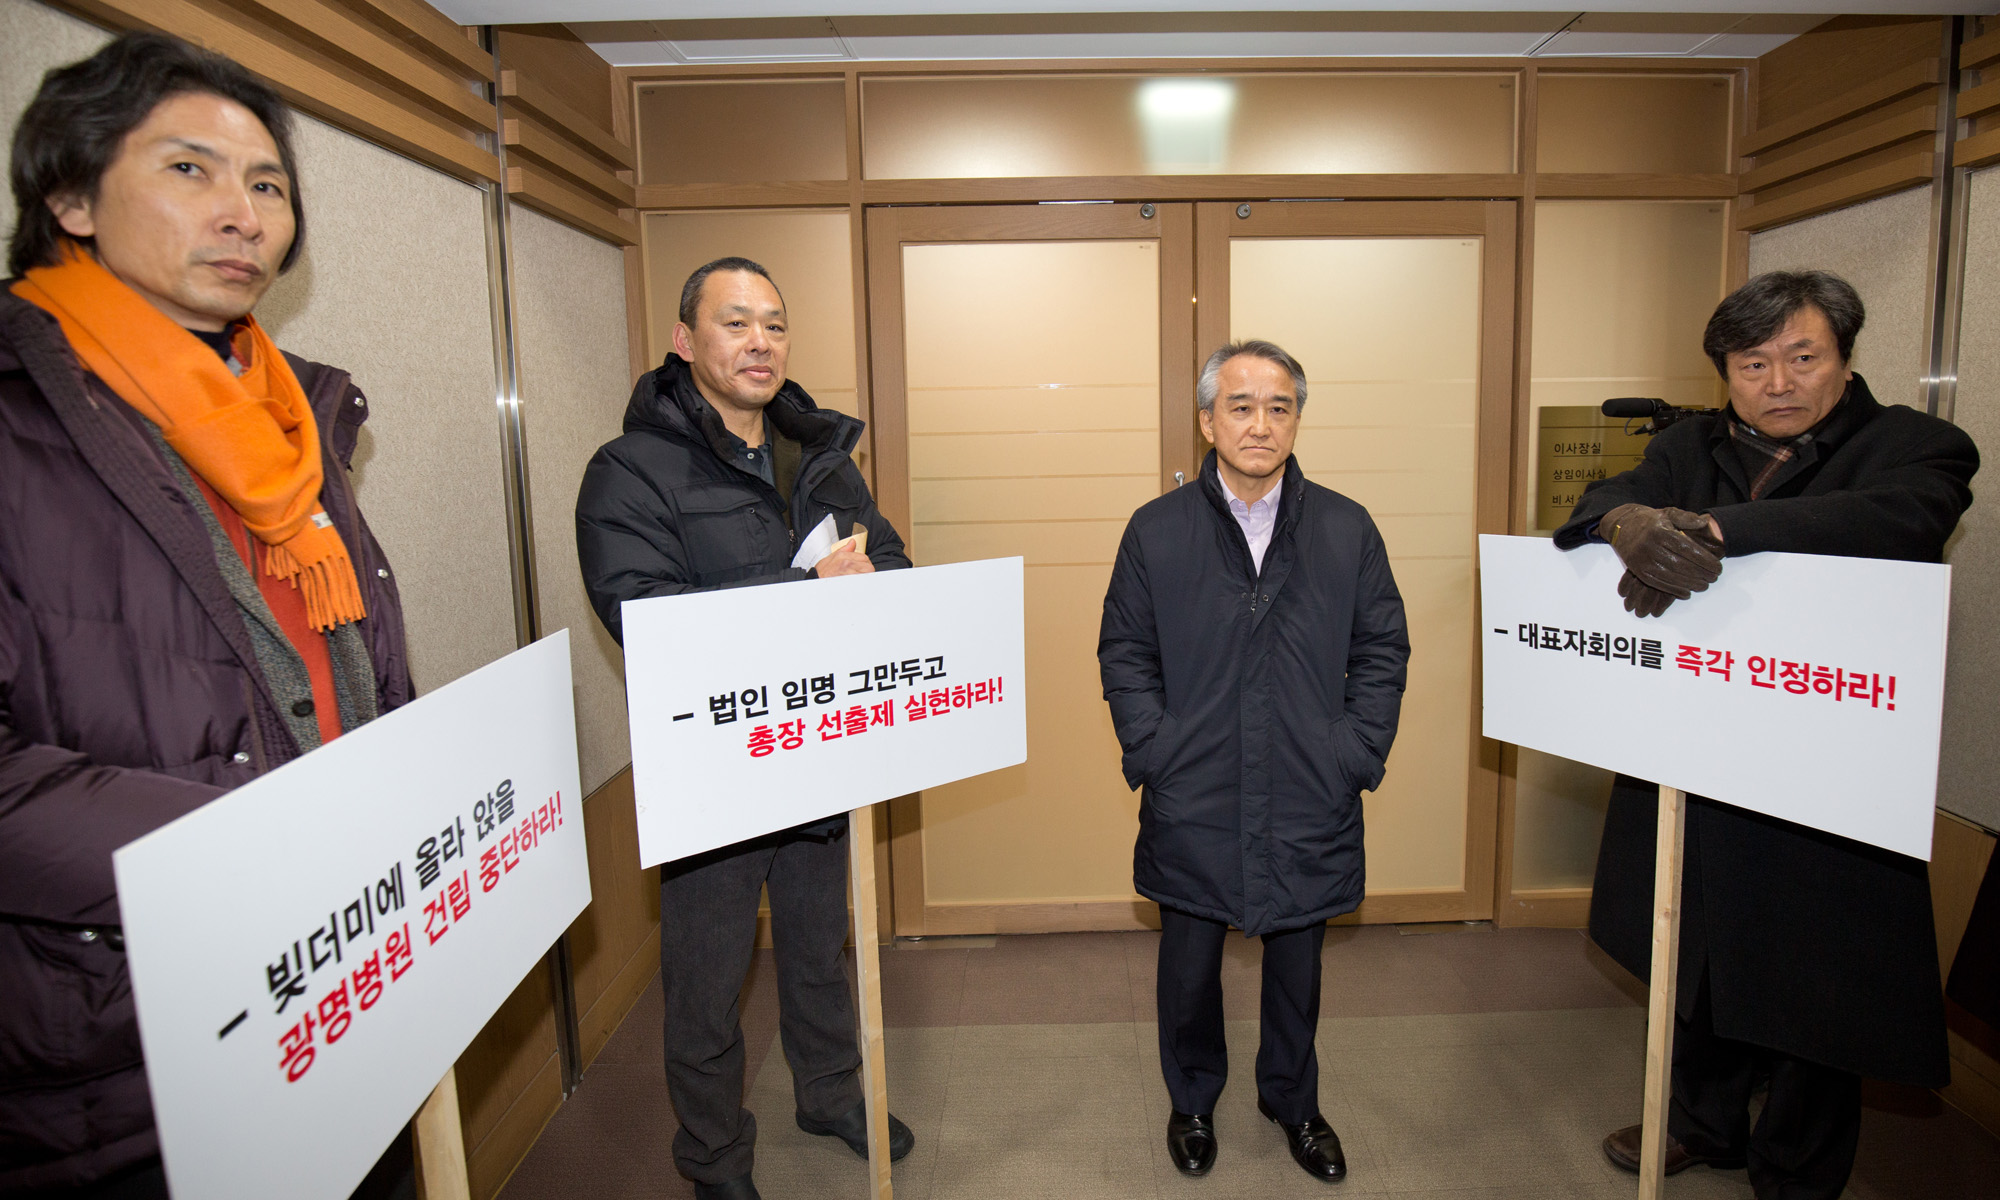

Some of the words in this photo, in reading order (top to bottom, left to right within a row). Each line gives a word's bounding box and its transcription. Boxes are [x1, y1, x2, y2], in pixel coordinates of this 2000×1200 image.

[1552, 468, 1607, 480] 상임이사실
[1553, 442, 1602, 455] 이사장실
[709, 685, 769, 726] 법인
[781, 673, 836, 711] 임명
[847, 655, 948, 696] 그만두고
[1518, 622, 1666, 671] 대표자회의를
[1675, 644, 1736, 684] 즉각
[1747, 655, 1897, 712] 인정하라!
[746, 717, 806, 758] 총장
[816, 698, 895, 743] 선출제
[903, 676, 1004, 723] 실현하라!
[265, 861, 405, 1015] 빚더미에
[414, 815, 466, 891] 올라
[473, 777, 516, 843] 앉을
[277, 922, 415, 1084] 광명병원
[422, 868, 472, 946] 건립
[479, 790, 564, 894] 중단하라!
